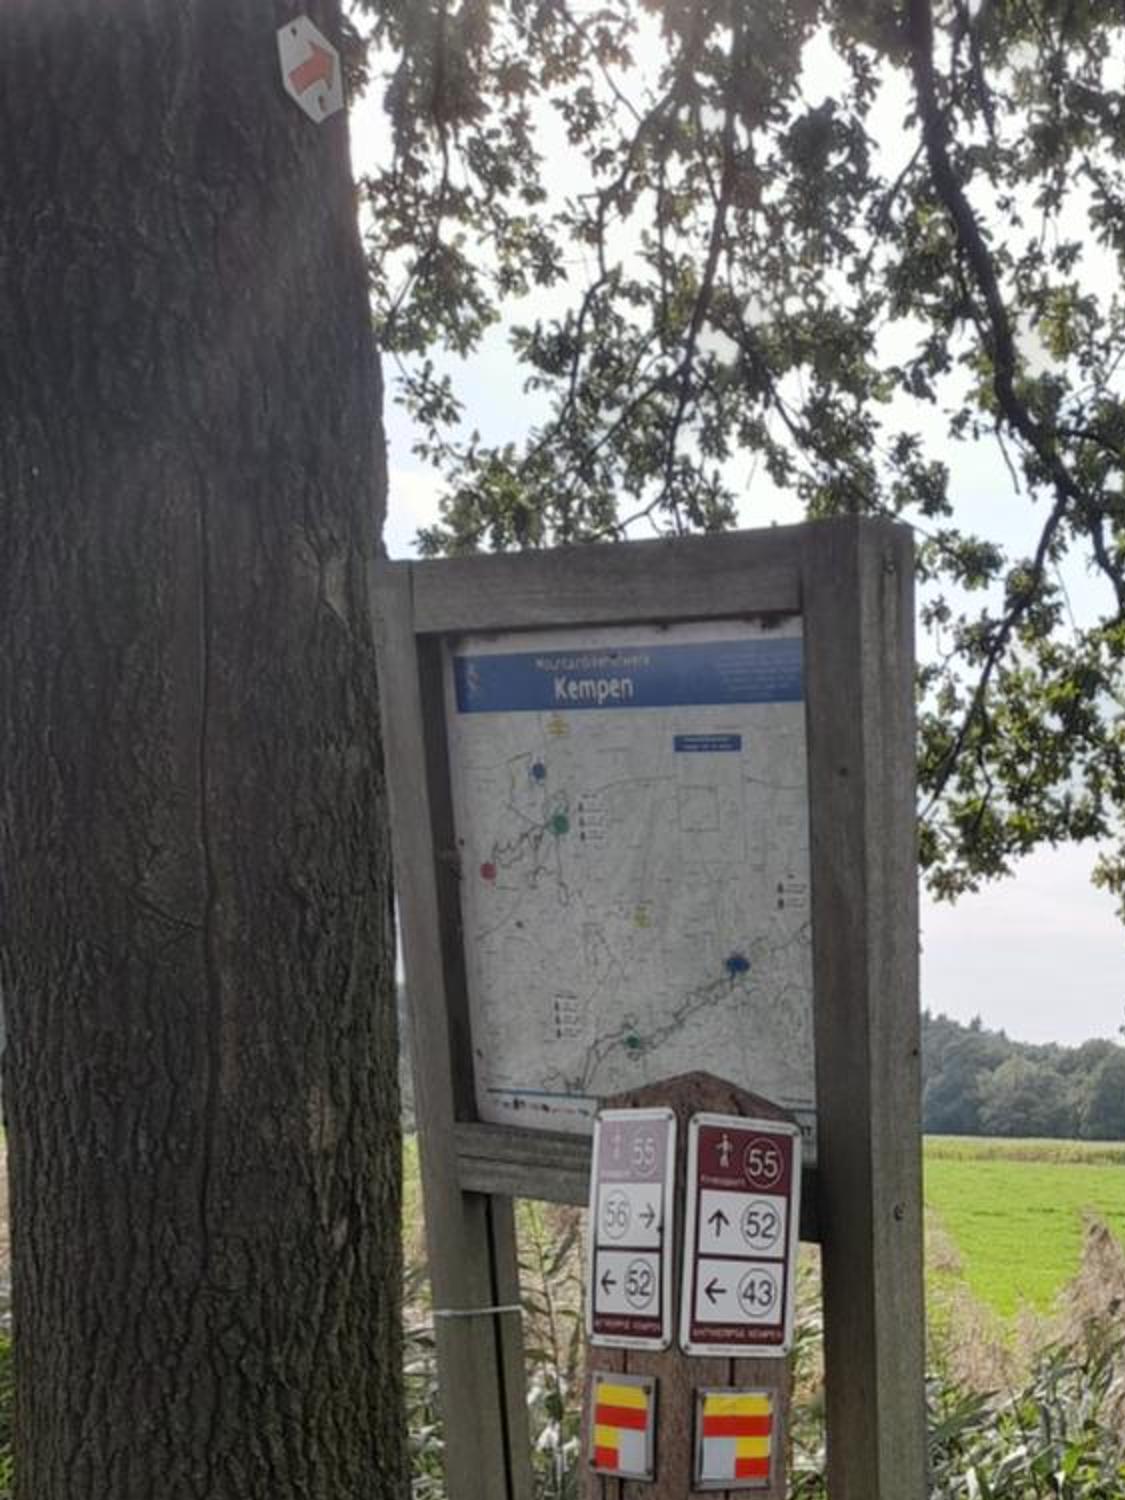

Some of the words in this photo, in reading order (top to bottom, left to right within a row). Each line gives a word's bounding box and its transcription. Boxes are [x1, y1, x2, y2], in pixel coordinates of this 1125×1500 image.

[553, 676, 634, 704] Kempen
[632, 1136, 655, 1166] 55
[748, 1148, 779, 1179] 55
[745, 1210, 777, 1240] 52
[625, 1269, 652, 1297] 52
[742, 1279, 773, 1307] 43
